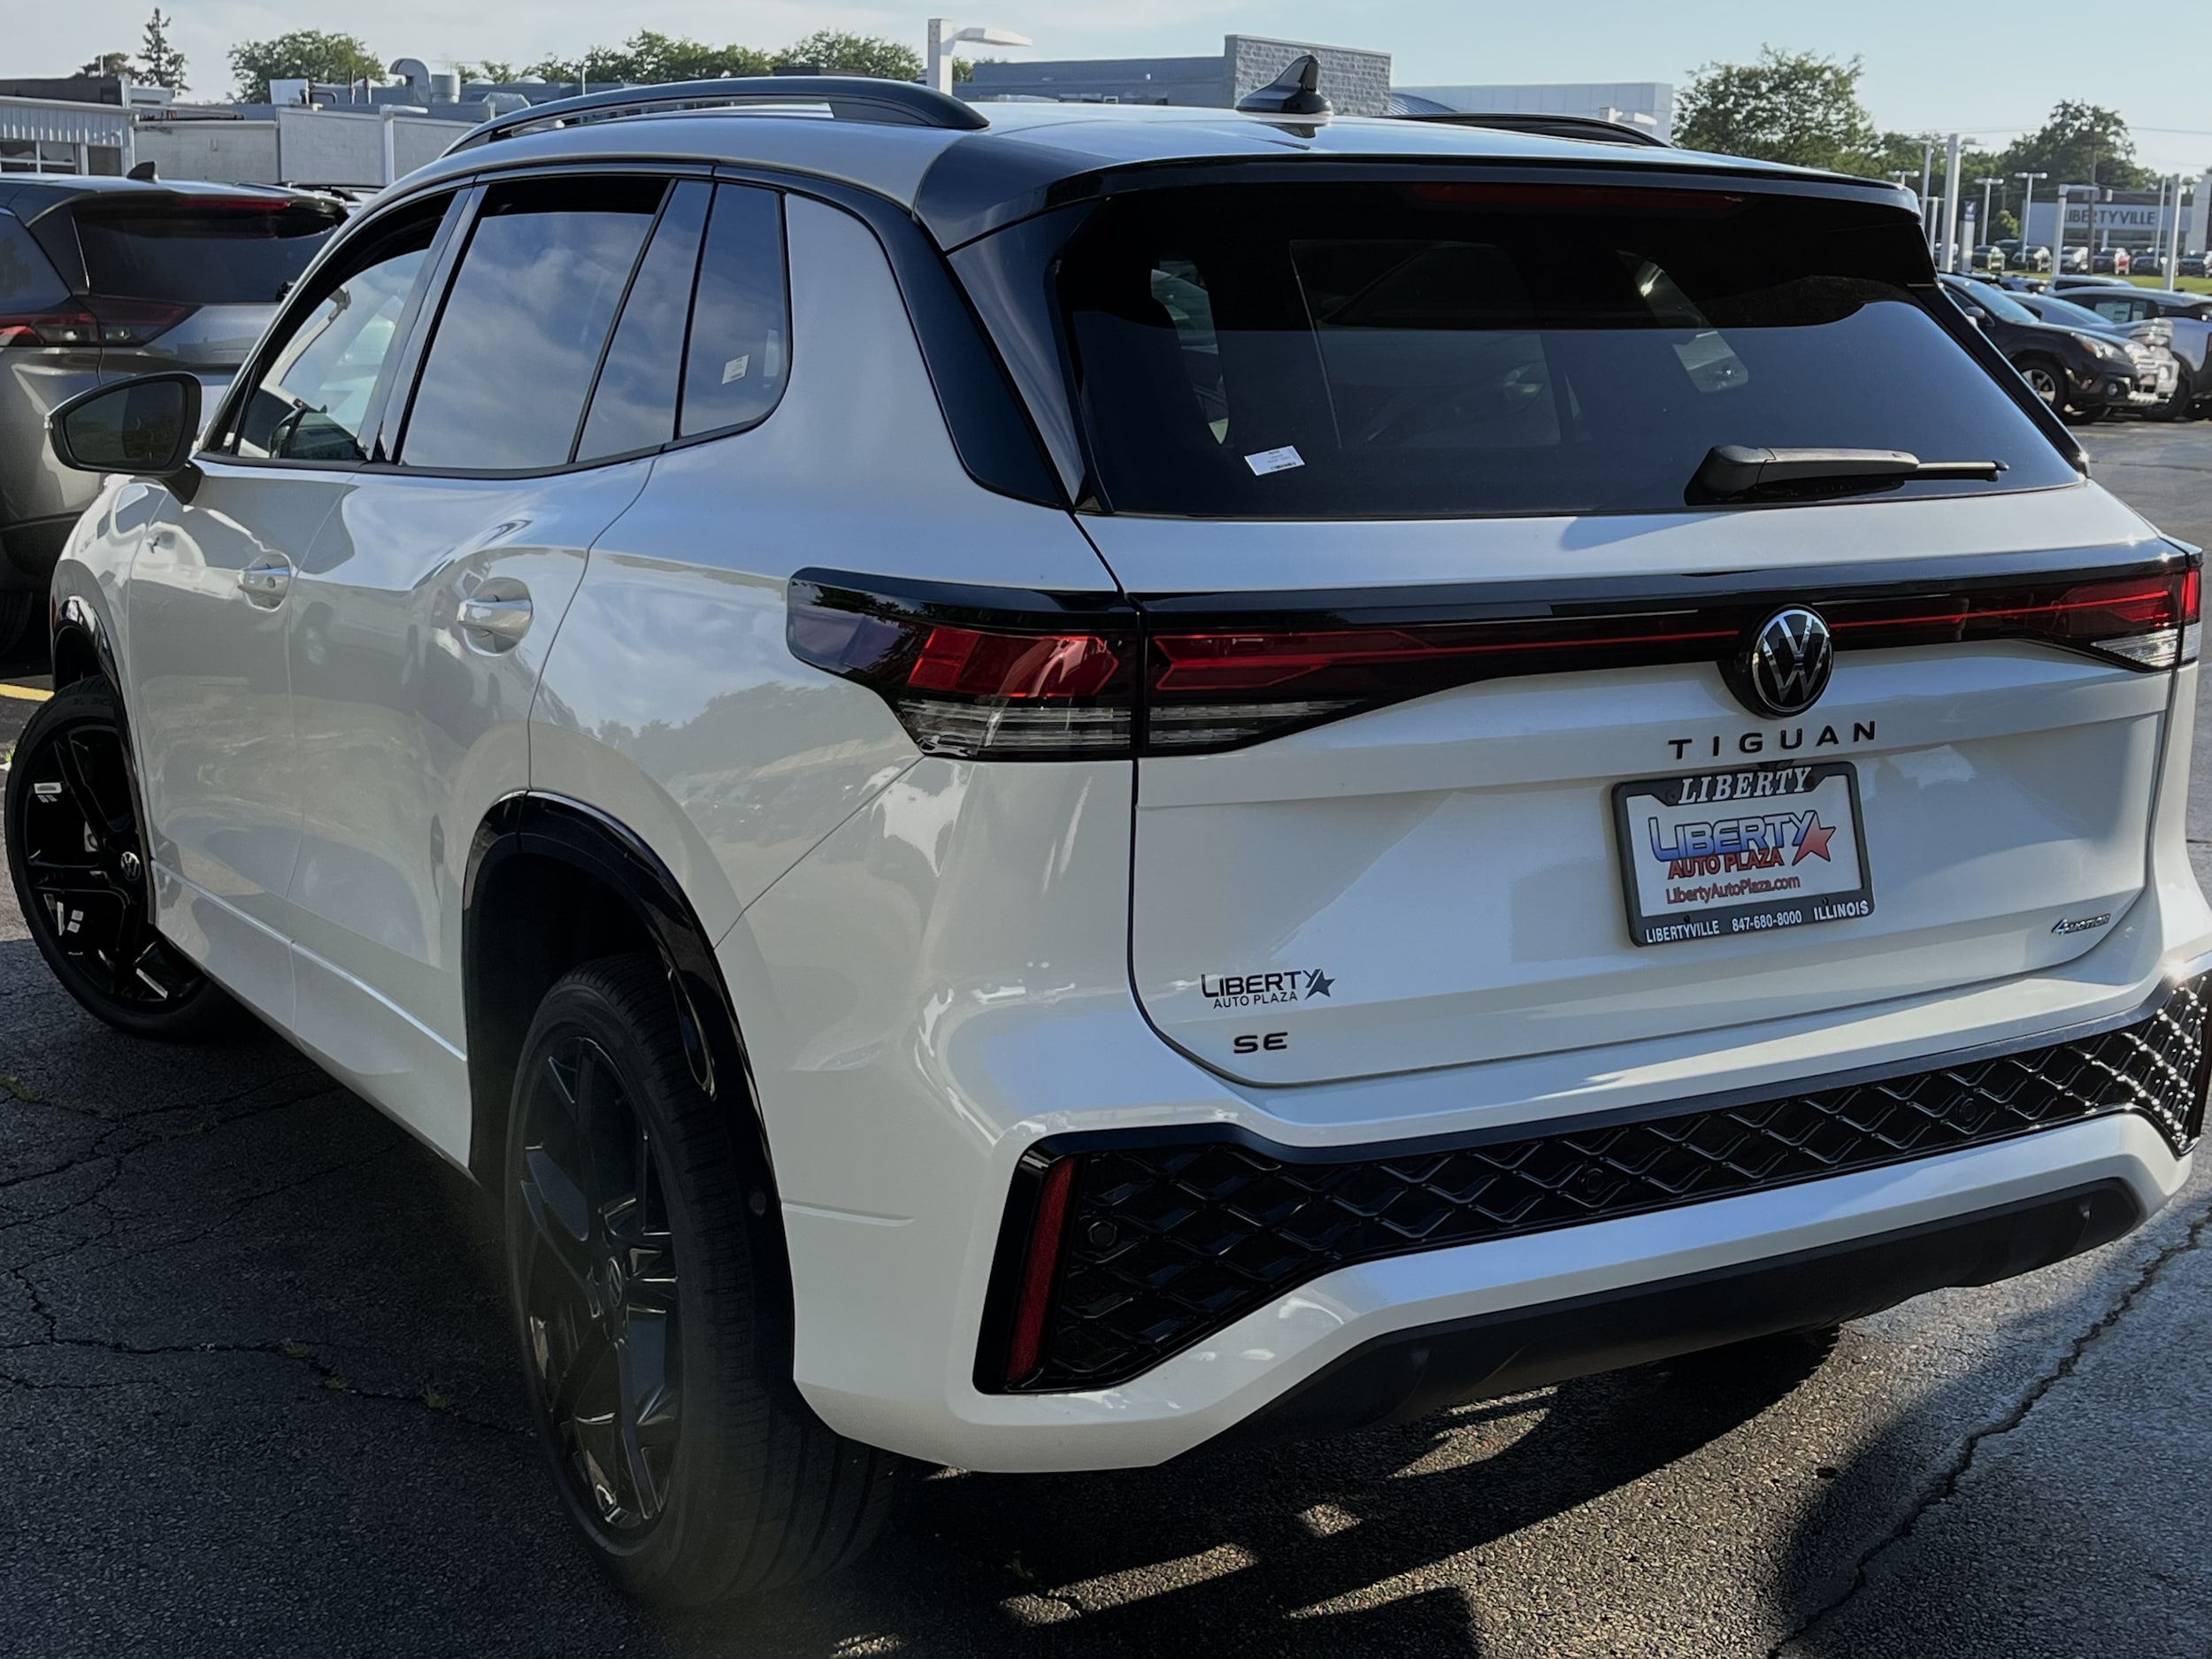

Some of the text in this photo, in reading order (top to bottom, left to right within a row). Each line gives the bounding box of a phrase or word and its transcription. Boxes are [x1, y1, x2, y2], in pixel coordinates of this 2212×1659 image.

[1668, 720, 1876, 759] TIGUAN
[1678, 766, 1813, 805] LIBERTY
[1647, 810, 1816, 863] LIBERTY
[1667, 847, 1785, 880] AUTO PLAZA
[1665, 874, 1801, 904] LibertyAutoPlaza.com
[1645, 899, 1870, 944] LIBERTYVILLE 847-680-8000 ILLINOIS
[1200, 968, 1324, 998] LIBERTY
[1212, 990, 1299, 1010] AUTO PLAZA
[1233, 1032, 1289, 1055] SE
